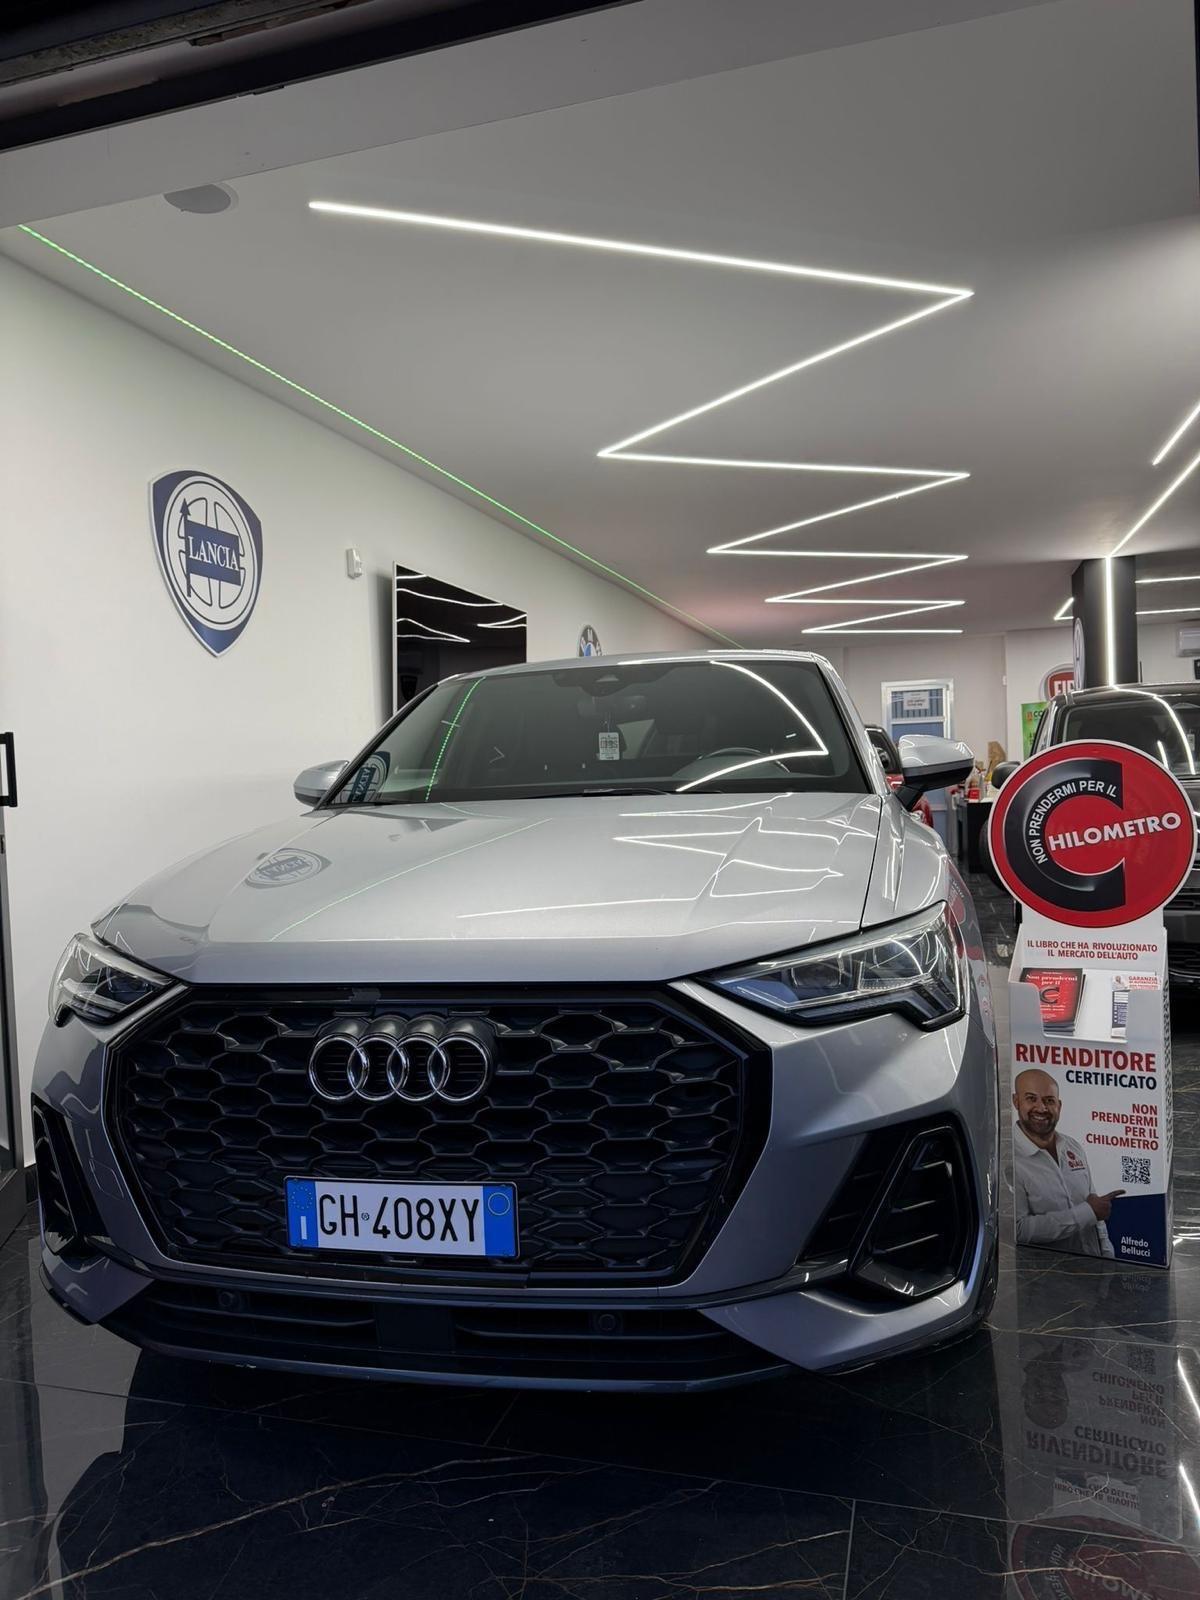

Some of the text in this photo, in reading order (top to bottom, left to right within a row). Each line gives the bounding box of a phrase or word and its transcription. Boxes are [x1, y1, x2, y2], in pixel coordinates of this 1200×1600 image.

[188, 536, 239, 571] LANCIA
[1029, 780, 1118, 864] NON PRENDERMI PER IL
[1048, 812, 1182, 851] HILOMETRO
[1027, 940, 1158, 953] IL LIBRO CHE HA RIVOLUZIONATO
[1047, 949, 1139, 960] IL MERCATO DELL'AUTO
[1015, 1043, 1157, 1073] RIVENDITORE
[1066, 1069, 1157, 1090] CERTIFICATO
[1132, 1103, 1158, 1116] NON
[1091, 1111, 1158, 1127] PRENDERMI
[1124, 1125, 1159, 1139] PER IL
[1086, 1133, 1159, 1150] CHILOMETRO
[1121, 1236, 1149, 1248] Alfredo
[1121, 1245, 1151, 1257] Bellucci
